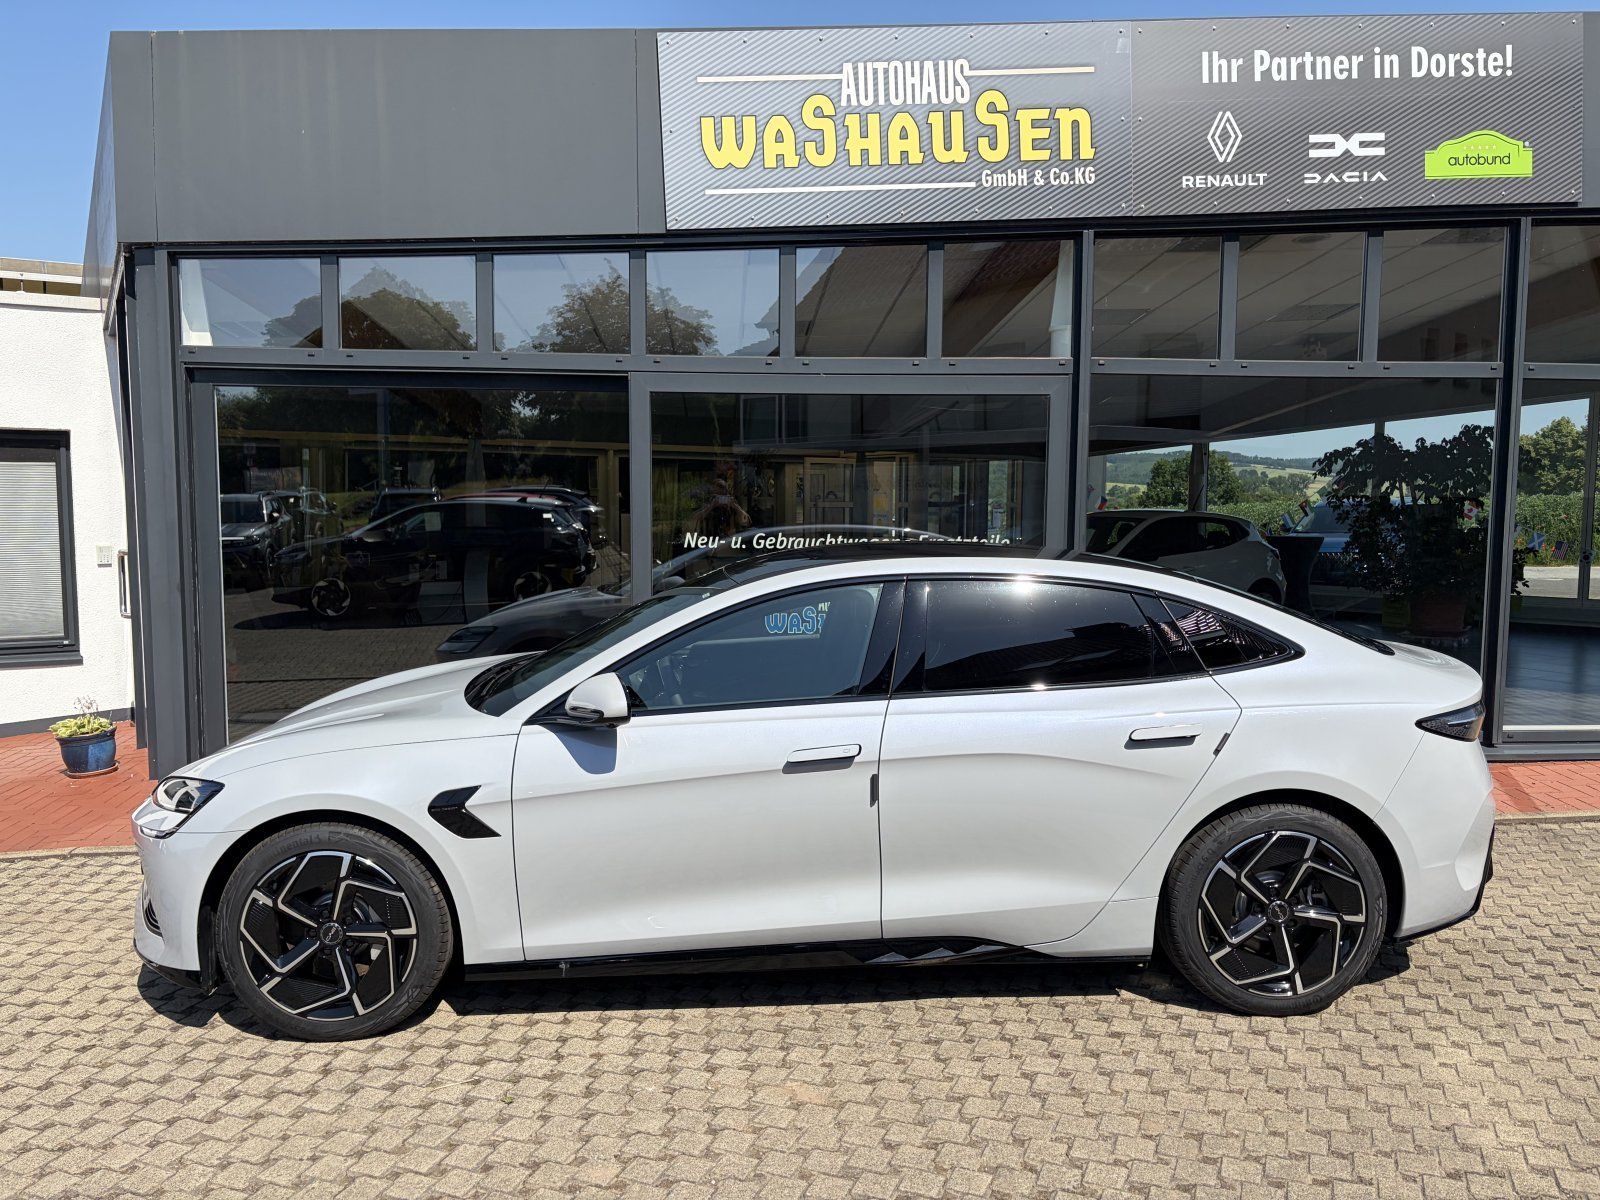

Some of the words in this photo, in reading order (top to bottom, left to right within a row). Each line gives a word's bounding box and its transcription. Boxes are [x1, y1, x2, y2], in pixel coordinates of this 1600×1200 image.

[1201, 51, 1243, 84] Ihr
[1253, 49, 1364, 82] Partner
[1373, 46, 1400, 79] in
[1411, 44, 1514, 78] Dorste!
[840, 58, 971, 107] AUTOHAUS
[700, 89, 1097, 170] WASHAUSEN
[1447, 152, 1511, 167] autobund
[981, 168, 1028, 187] GmbH
[1033, 169, 1045, 186] &
[1049, 166, 1096, 186] Co.KG
[1181, 173, 1268, 188] RENAULT
[1303, 171, 1389, 184] DACIA
[683, 532, 726, 549] Neu-
[731, 534, 746, 549] u.
